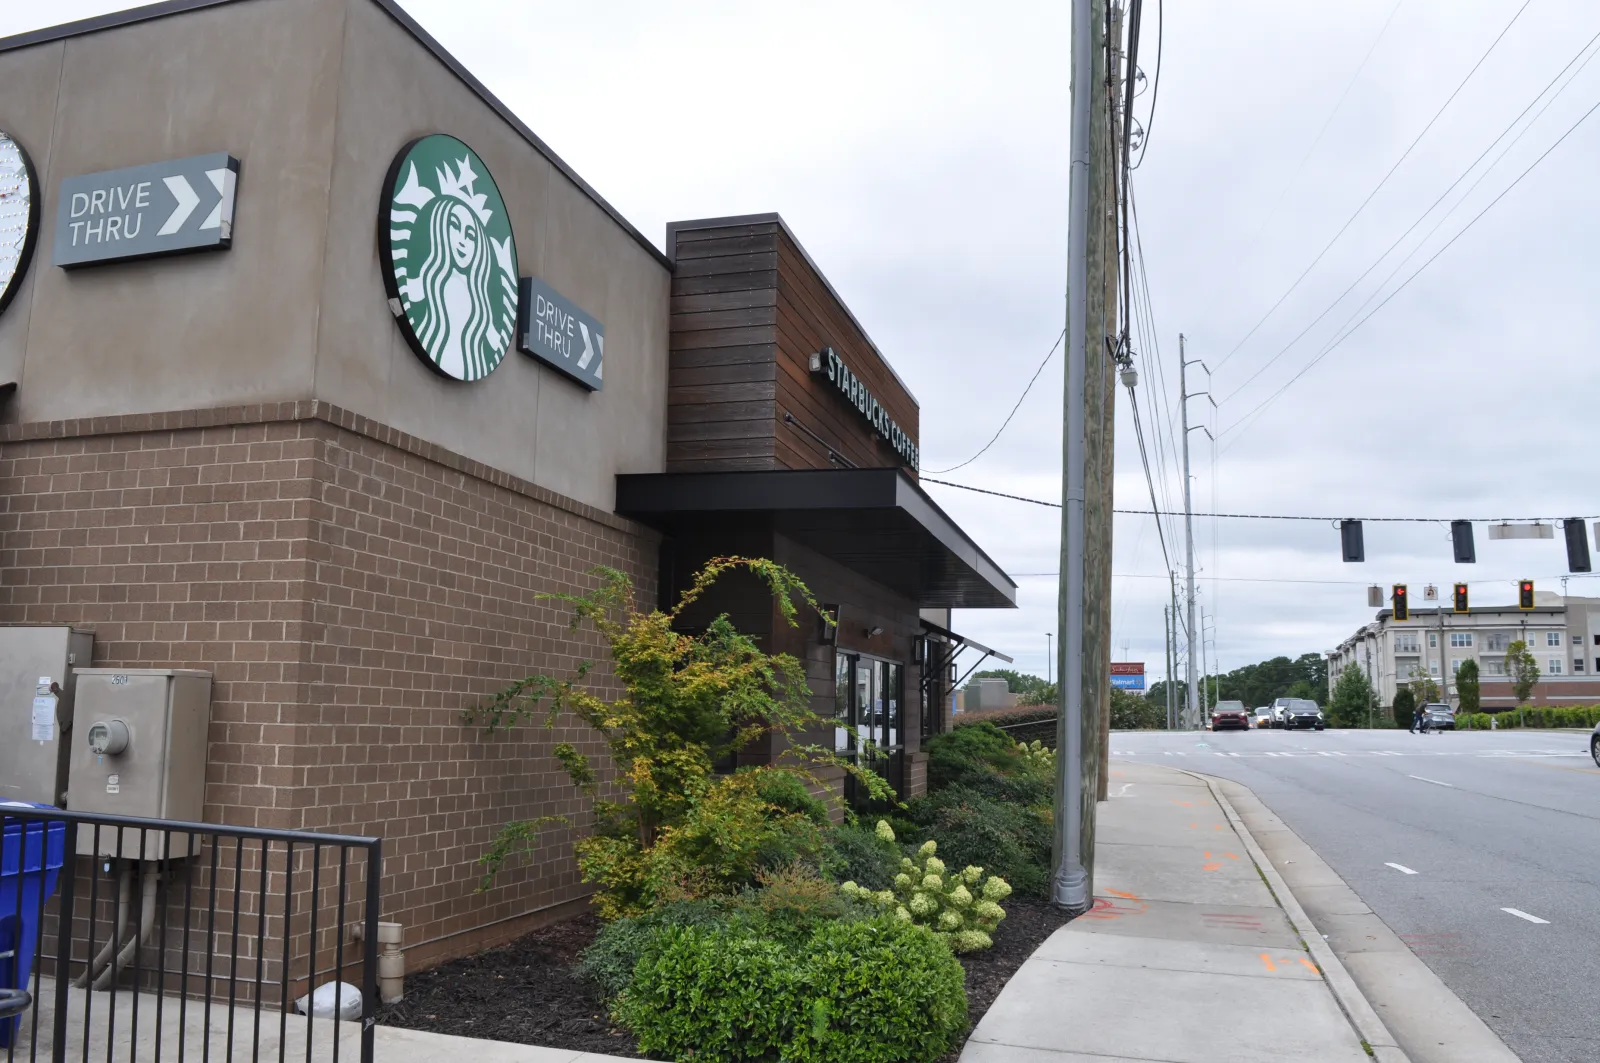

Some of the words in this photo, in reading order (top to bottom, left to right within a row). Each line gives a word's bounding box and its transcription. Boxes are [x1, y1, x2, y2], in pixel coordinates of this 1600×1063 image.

[69, 181, 152, 218] DRIVE
[68, 212, 143, 247] THRU
[536, 294, 575, 338] DRIVE
[535, 319, 571, 358] THRU
[828, 346, 889, 440] STARBUCKS
[890, 420, 920, 472] COFFEE
